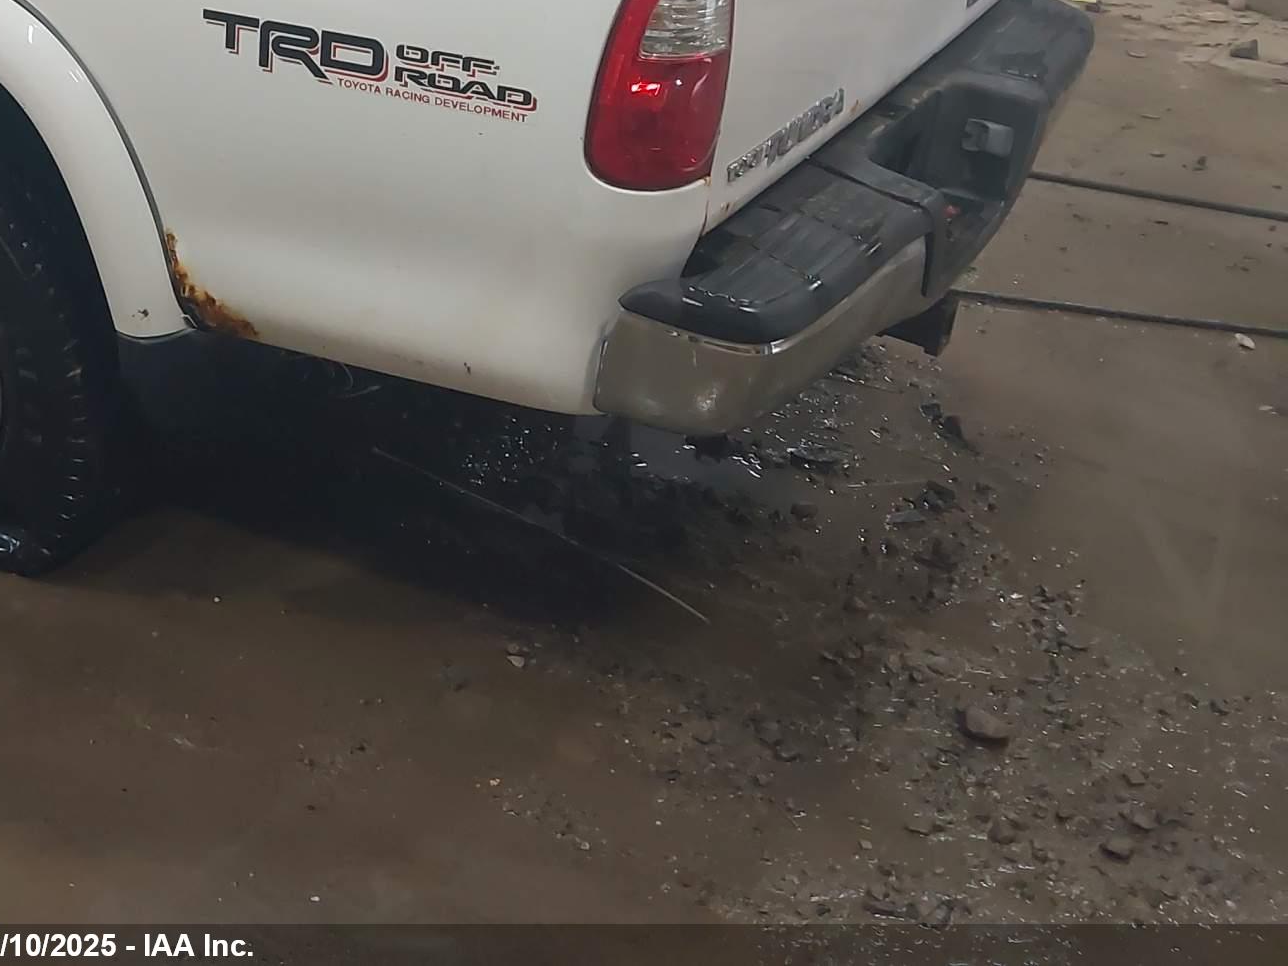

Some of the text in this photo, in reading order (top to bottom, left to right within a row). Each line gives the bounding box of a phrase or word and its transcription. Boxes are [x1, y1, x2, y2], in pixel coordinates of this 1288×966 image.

[202, 8, 389, 84] TRD
[395, 43, 500, 77] OFF
[337, 77, 528, 123] TOYOTA RACING DEVELOPMENT
[394, 65, 537, 112] ROAD
